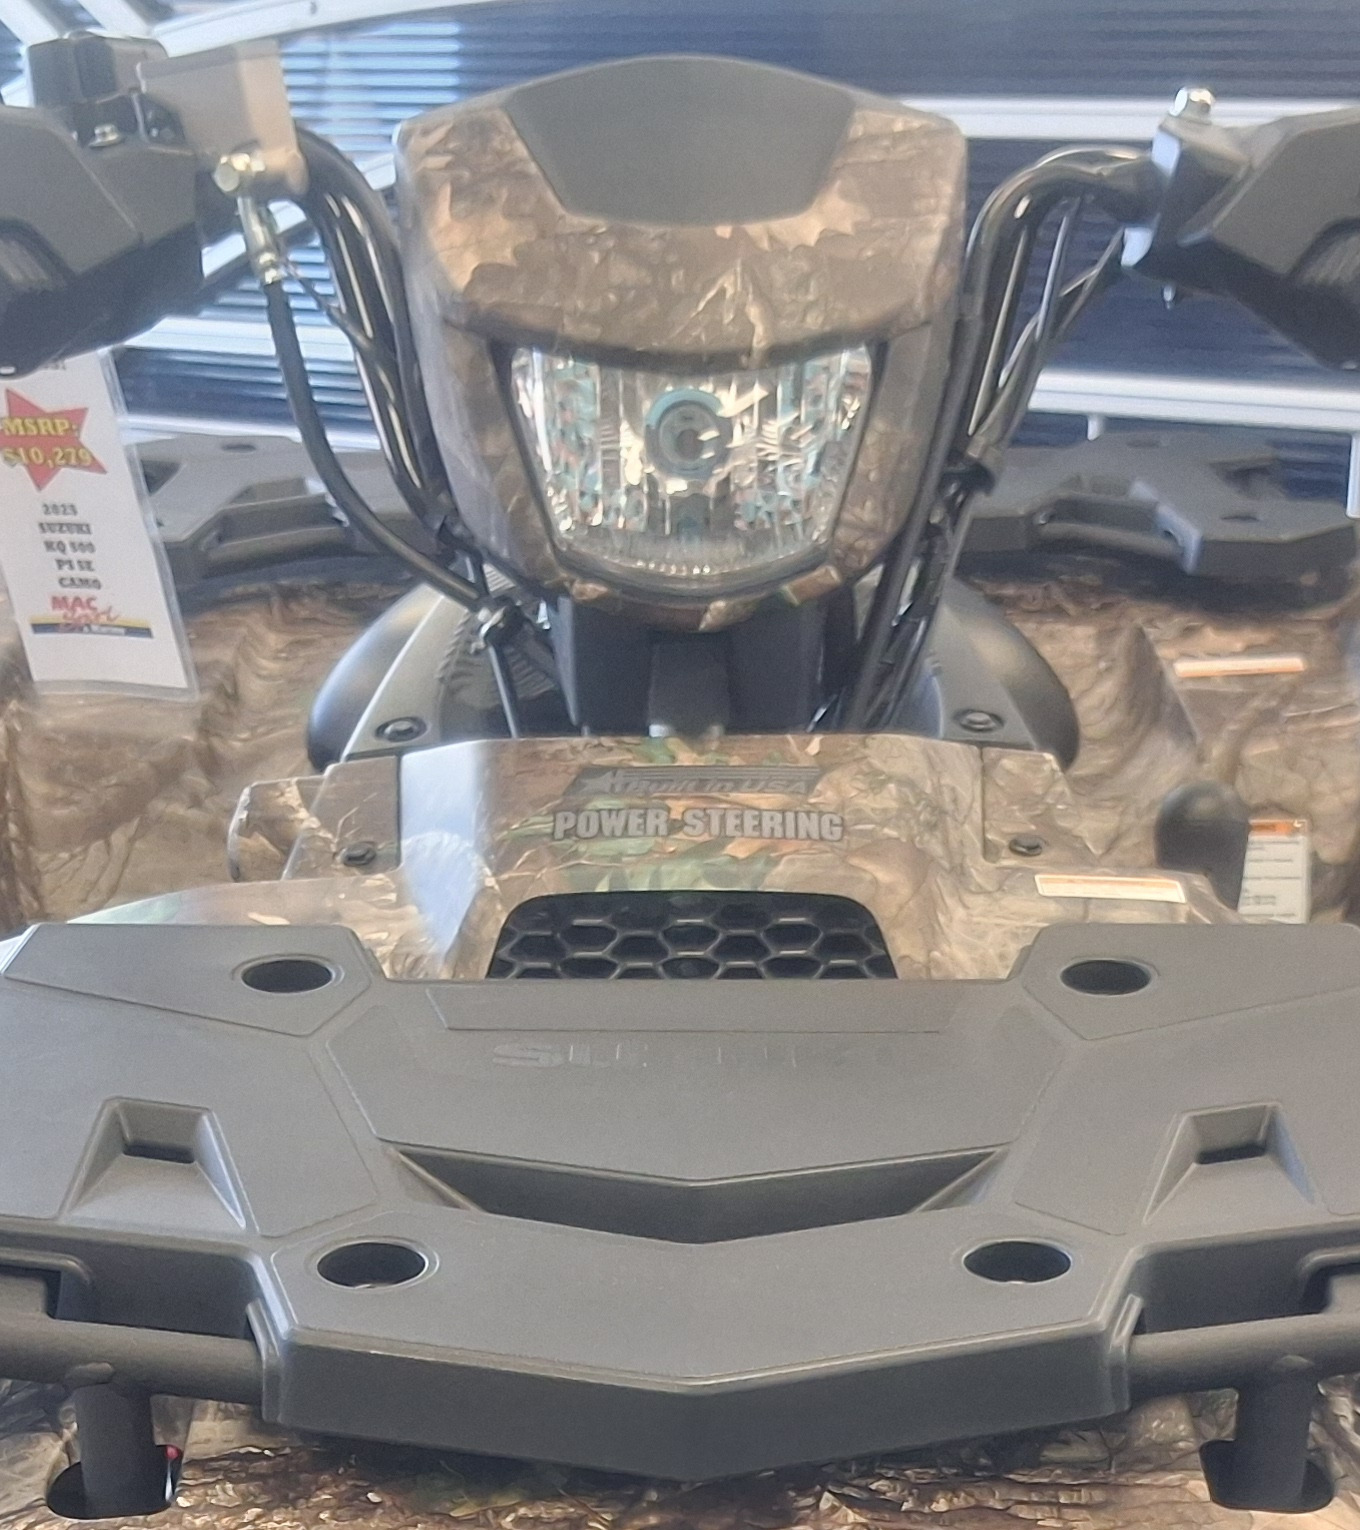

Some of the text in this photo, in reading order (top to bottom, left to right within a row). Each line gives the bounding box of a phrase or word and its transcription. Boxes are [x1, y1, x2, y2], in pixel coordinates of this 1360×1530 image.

[0, 417, 81, 437] MSRP:
[552, 807, 844, 842] POWER STEERING
